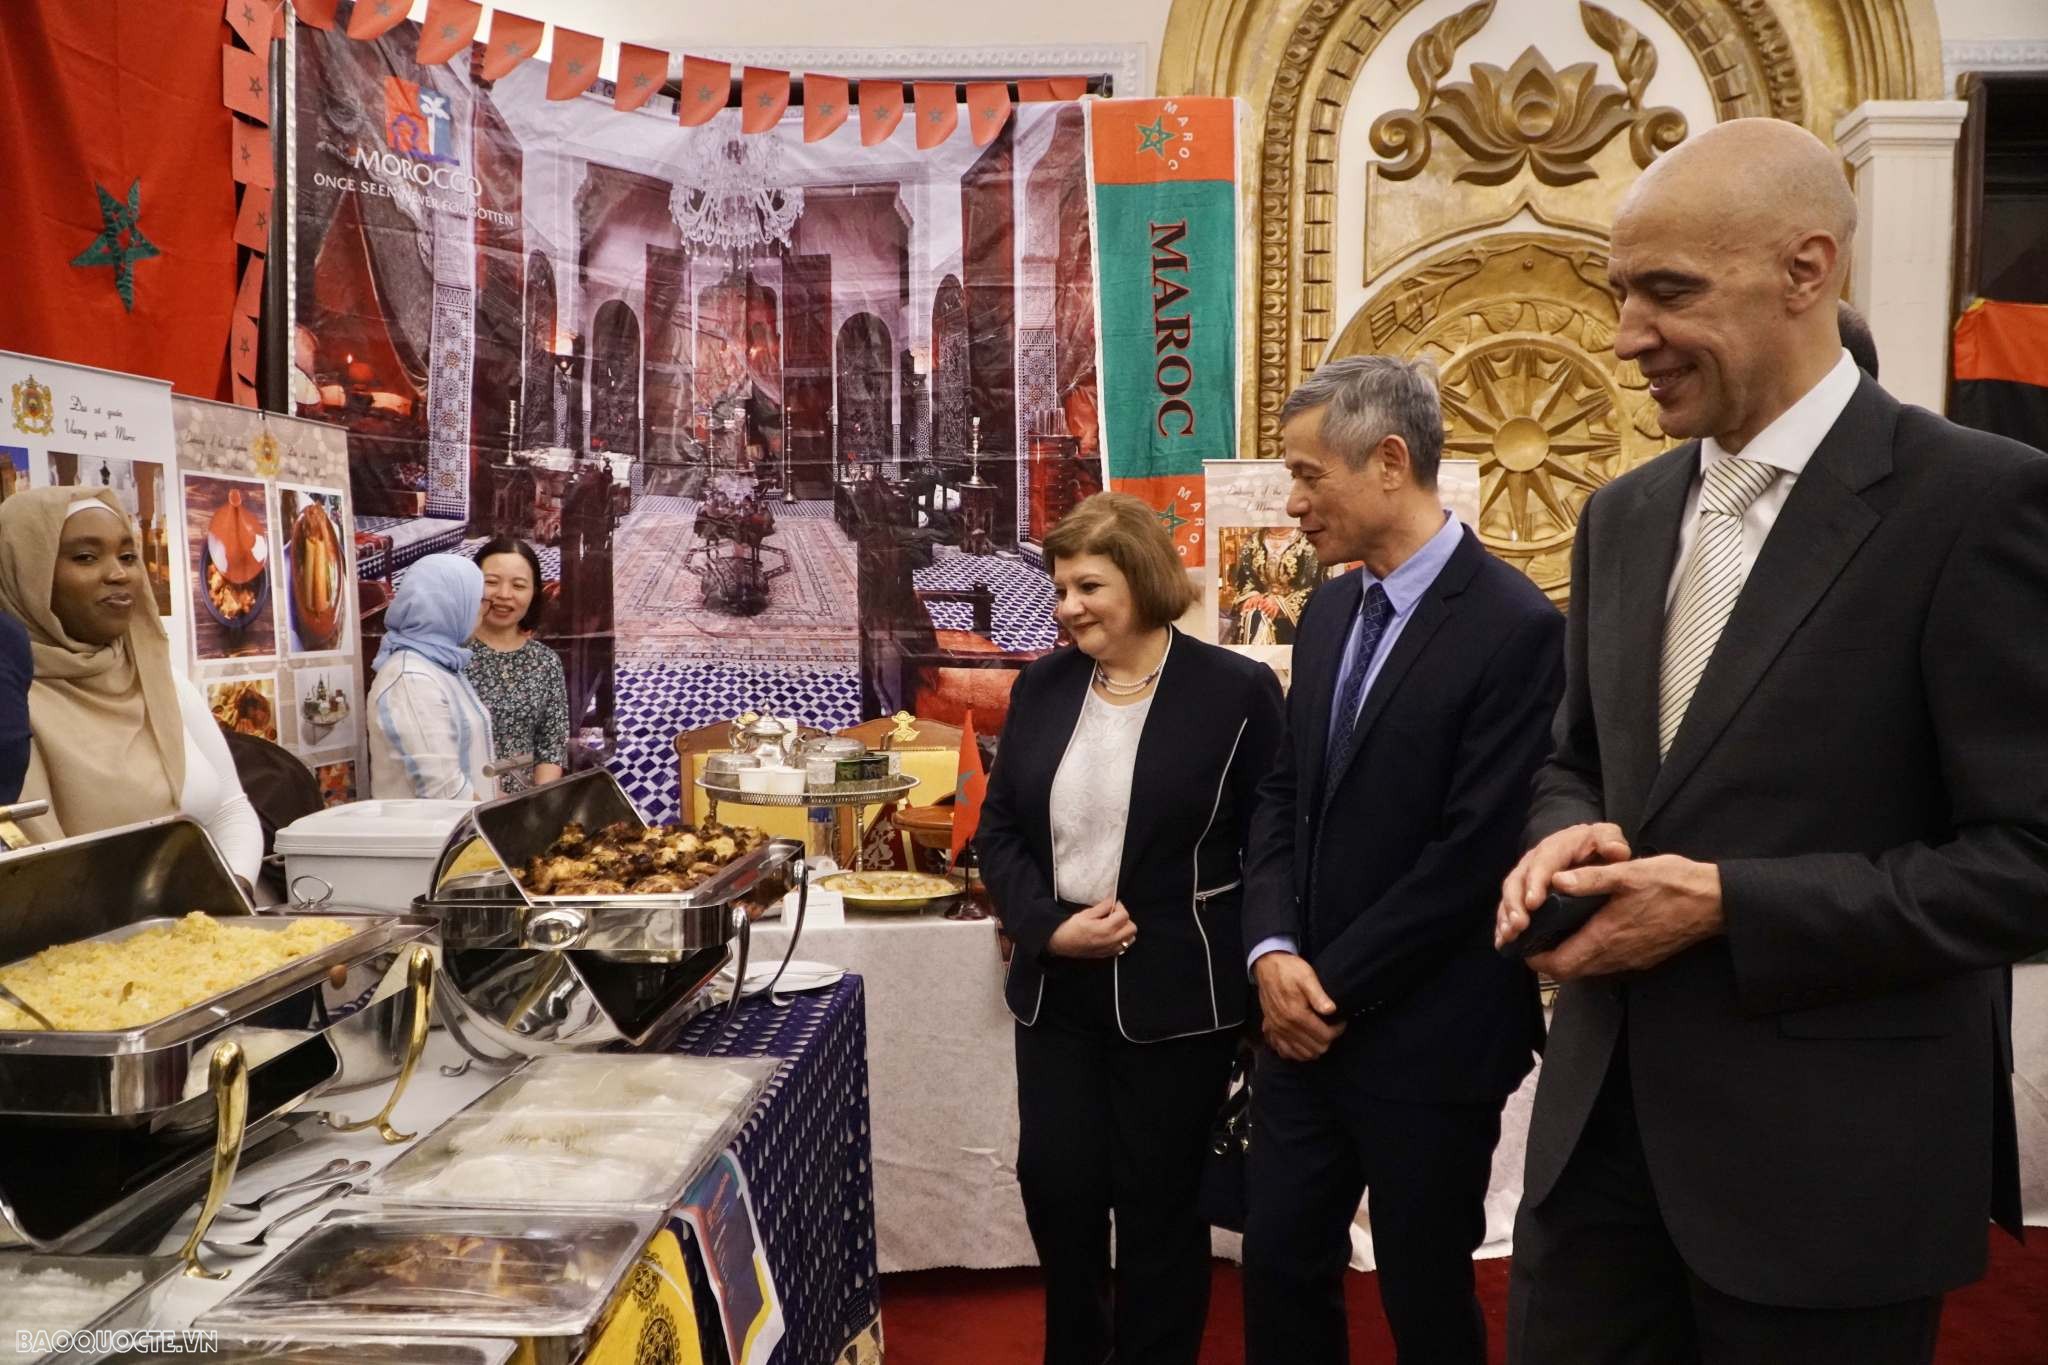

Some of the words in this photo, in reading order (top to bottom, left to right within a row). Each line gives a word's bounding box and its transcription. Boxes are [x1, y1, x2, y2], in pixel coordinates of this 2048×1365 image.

[1163, 101, 1194, 171] MAROC
[313, 172, 356, 192] ONCE
[360, 181, 398, 198] SEEN
[399, 187, 440, 209] NEVER
[441, 200, 514, 227] FORGOTTEN
[354, 147, 483, 197] MOROCCO
[1150, 219, 1195, 438] MAROC
[1177, 486, 1205, 556] MAROC
